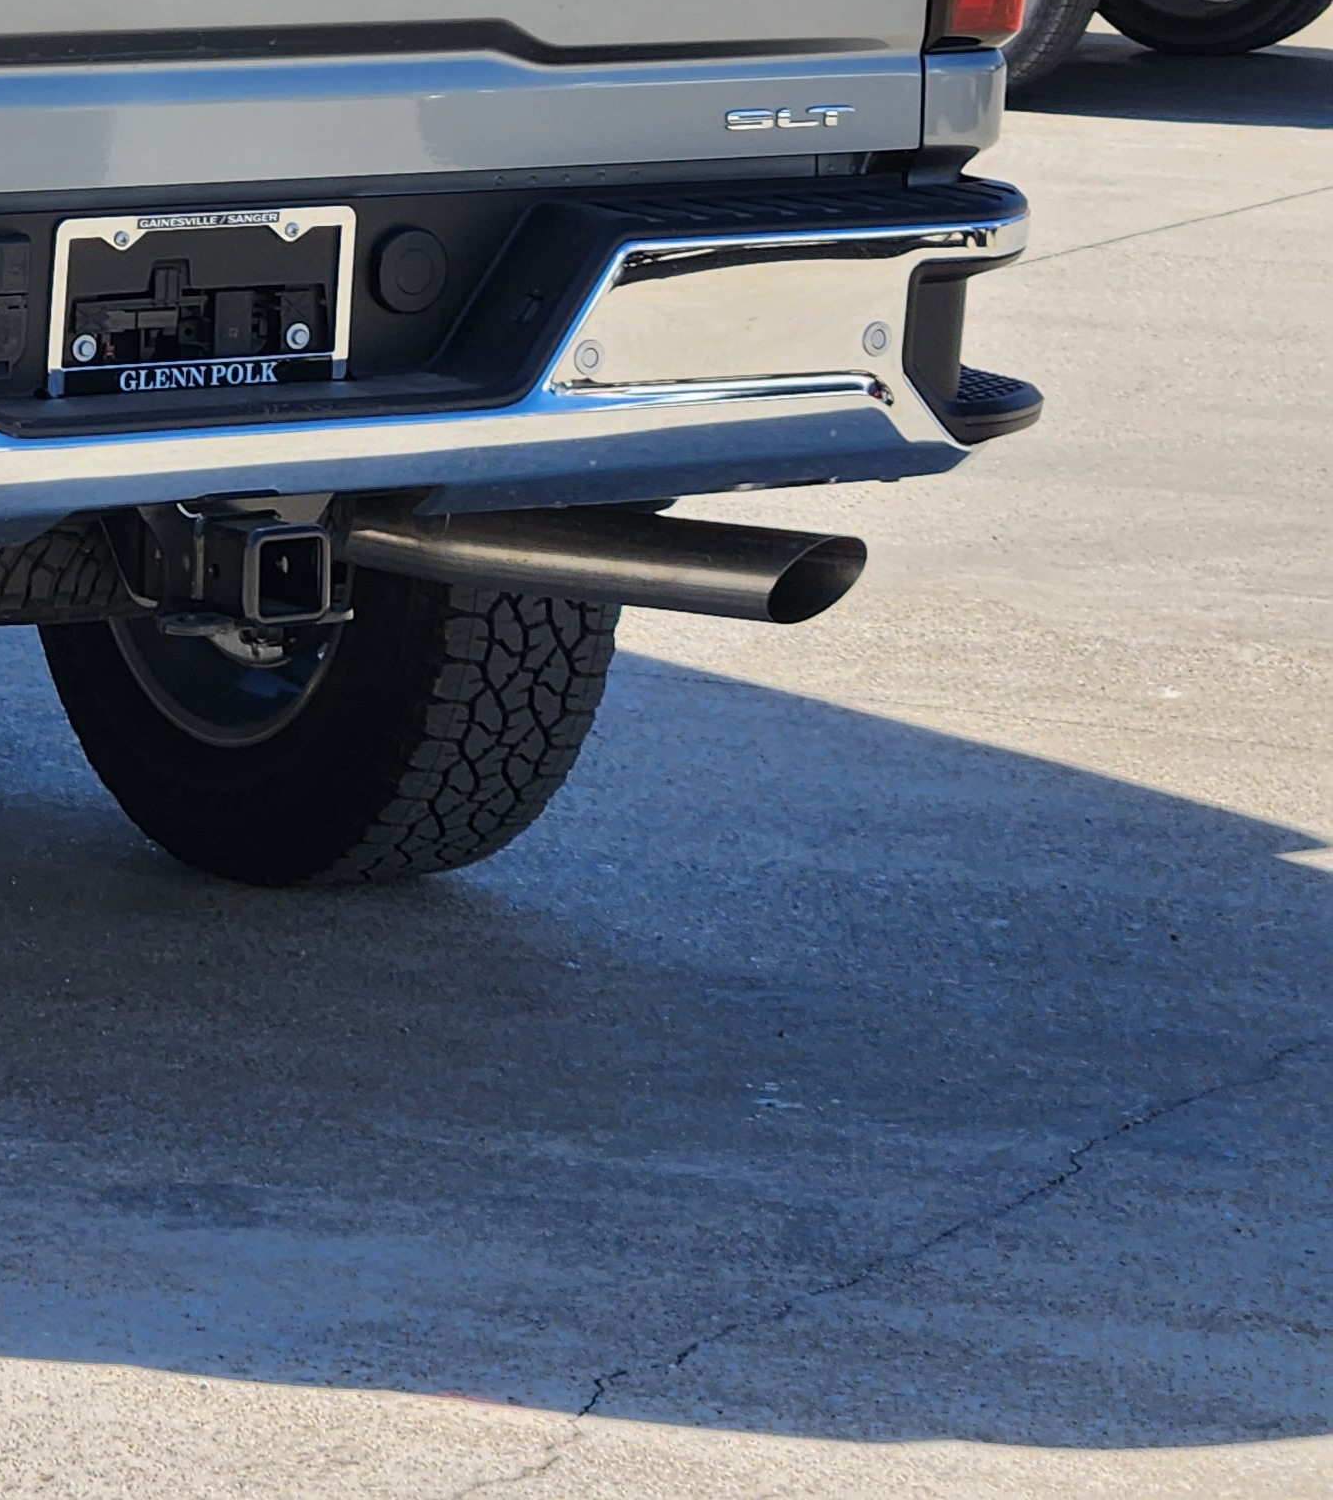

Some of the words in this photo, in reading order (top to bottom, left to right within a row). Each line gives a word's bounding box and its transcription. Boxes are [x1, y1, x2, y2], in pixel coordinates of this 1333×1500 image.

[725, 103, 856, 131] SLT
[119, 366, 206, 392] GLENN
[210, 361, 278, 386] POLK
